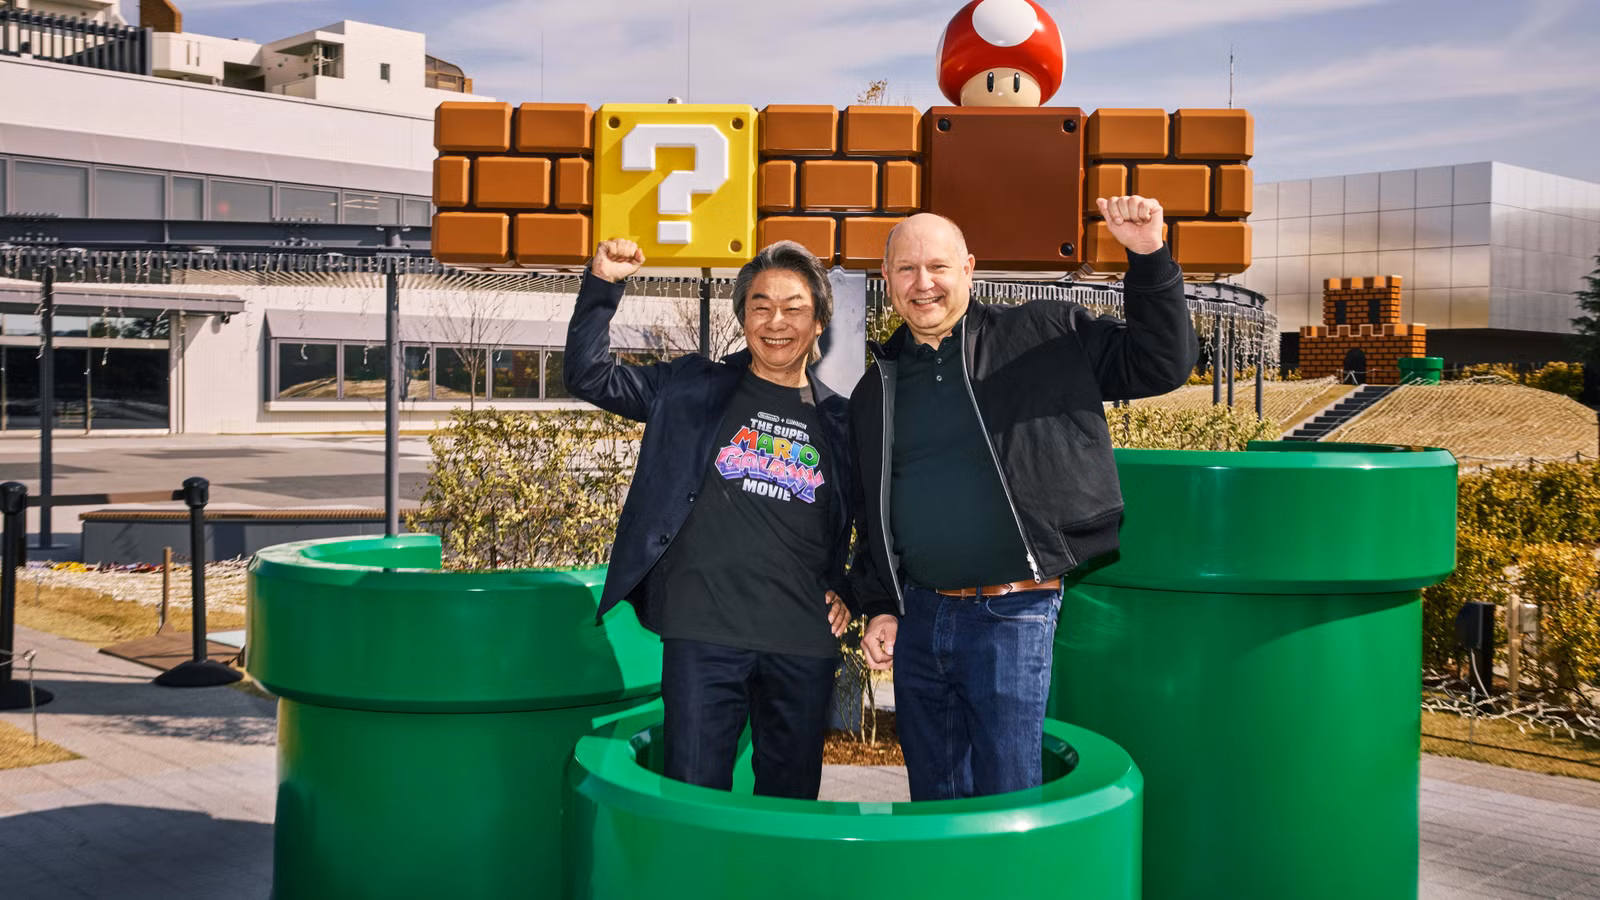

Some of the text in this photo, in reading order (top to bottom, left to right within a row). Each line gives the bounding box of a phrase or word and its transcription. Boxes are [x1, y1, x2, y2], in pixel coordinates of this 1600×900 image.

[622, 124, 729, 244] ?
[730, 425, 820, 468] MARIO
[750, 418, 773, 433] THE
[773, 426, 810, 443] SUPER
[715, 445, 825, 504] GALAXY
[742, 478, 791, 502] MOVIE
